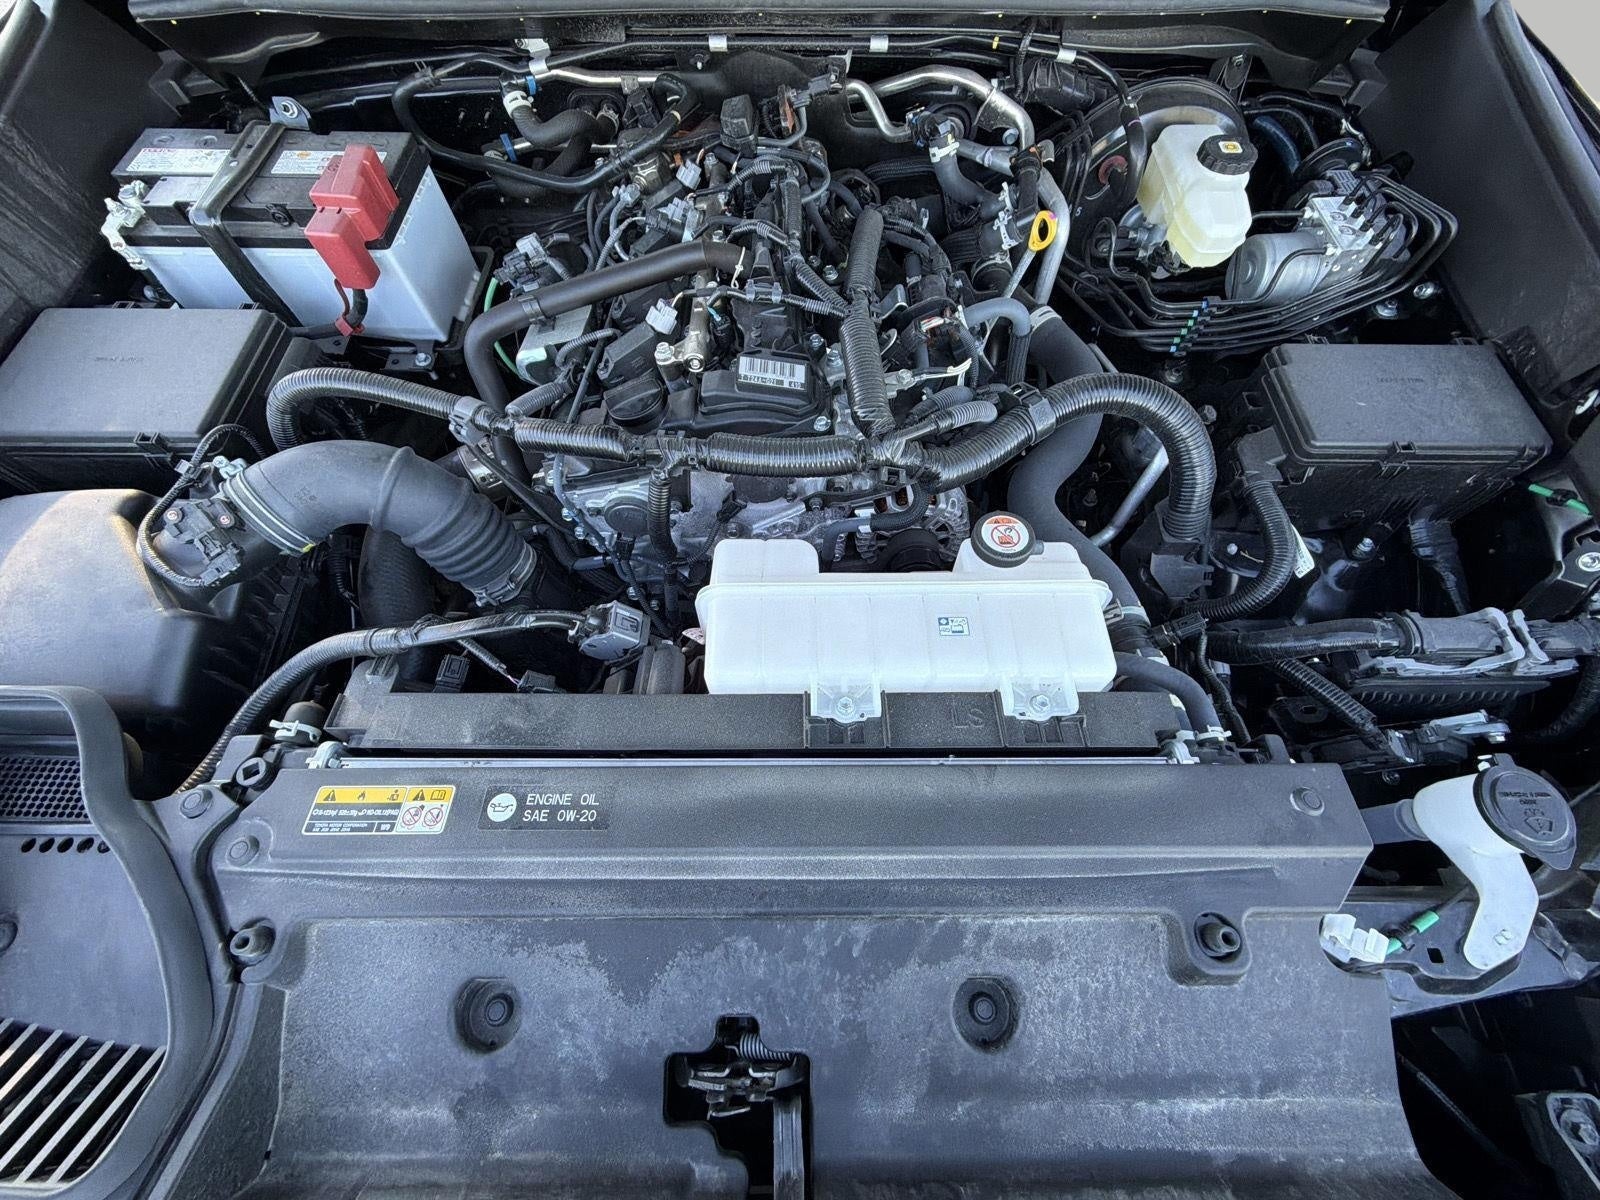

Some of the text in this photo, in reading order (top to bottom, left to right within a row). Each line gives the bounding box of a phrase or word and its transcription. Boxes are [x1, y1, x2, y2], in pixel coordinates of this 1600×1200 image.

[526, 793, 600, 805] ENGINE OIL
[522, 809, 597, 822] SAE 0W-20
